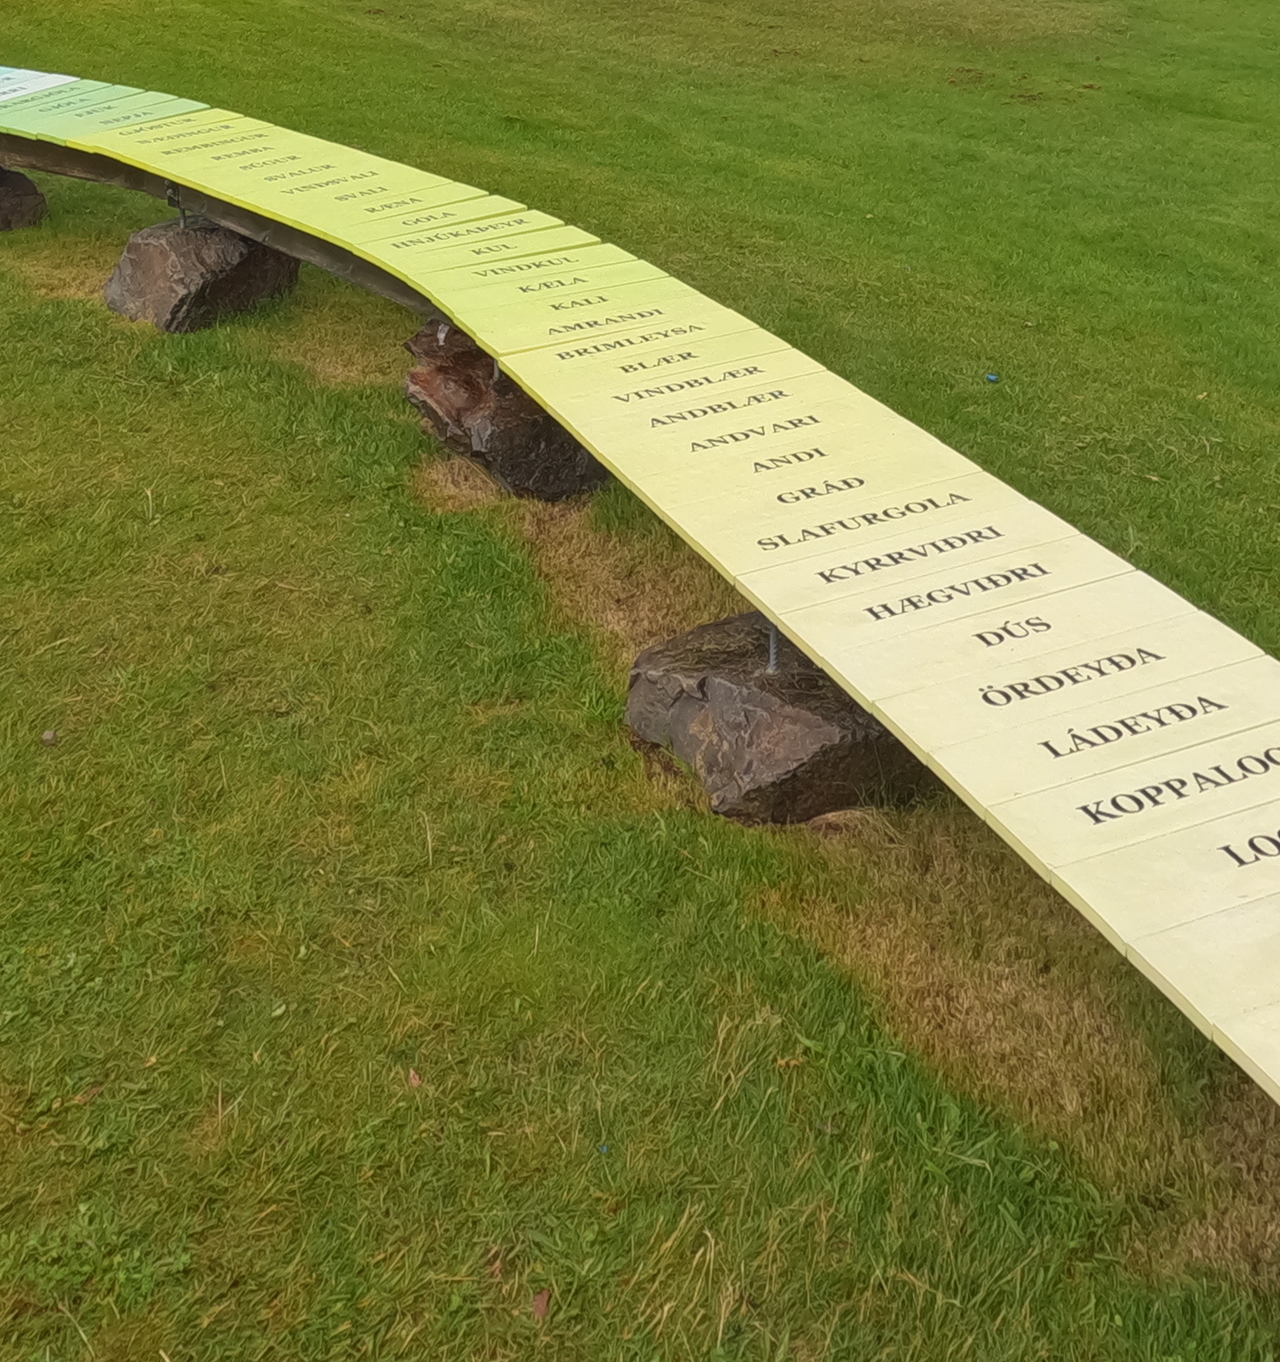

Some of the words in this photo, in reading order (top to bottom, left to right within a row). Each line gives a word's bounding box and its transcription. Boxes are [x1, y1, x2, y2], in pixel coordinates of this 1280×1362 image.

[333, 186, 388, 202] SVALI
[401, 211, 457, 226] GOLA
[470, 243, 518, 256] KUL
[471, 256, 580, 277] VINDKUL
[517, 277, 589, 294] KÆLA
[549, 295, 609, 311] KALI
[548, 308, 664, 336] AMRANDI
[555, 324, 704, 361] BRIMLEYSA
[618, 351, 699, 374] BLÆR
[611, 366, 765, 403] VINDBLÆR
[650, 390, 790, 429] ANDBLÆR
[691, 415, 821, 453] ANDVARI
[753, 447, 827, 473] ANDI
[756, 493, 971, 551] SLAFURGOLA
[972, 616, 1052, 647] DÚS
